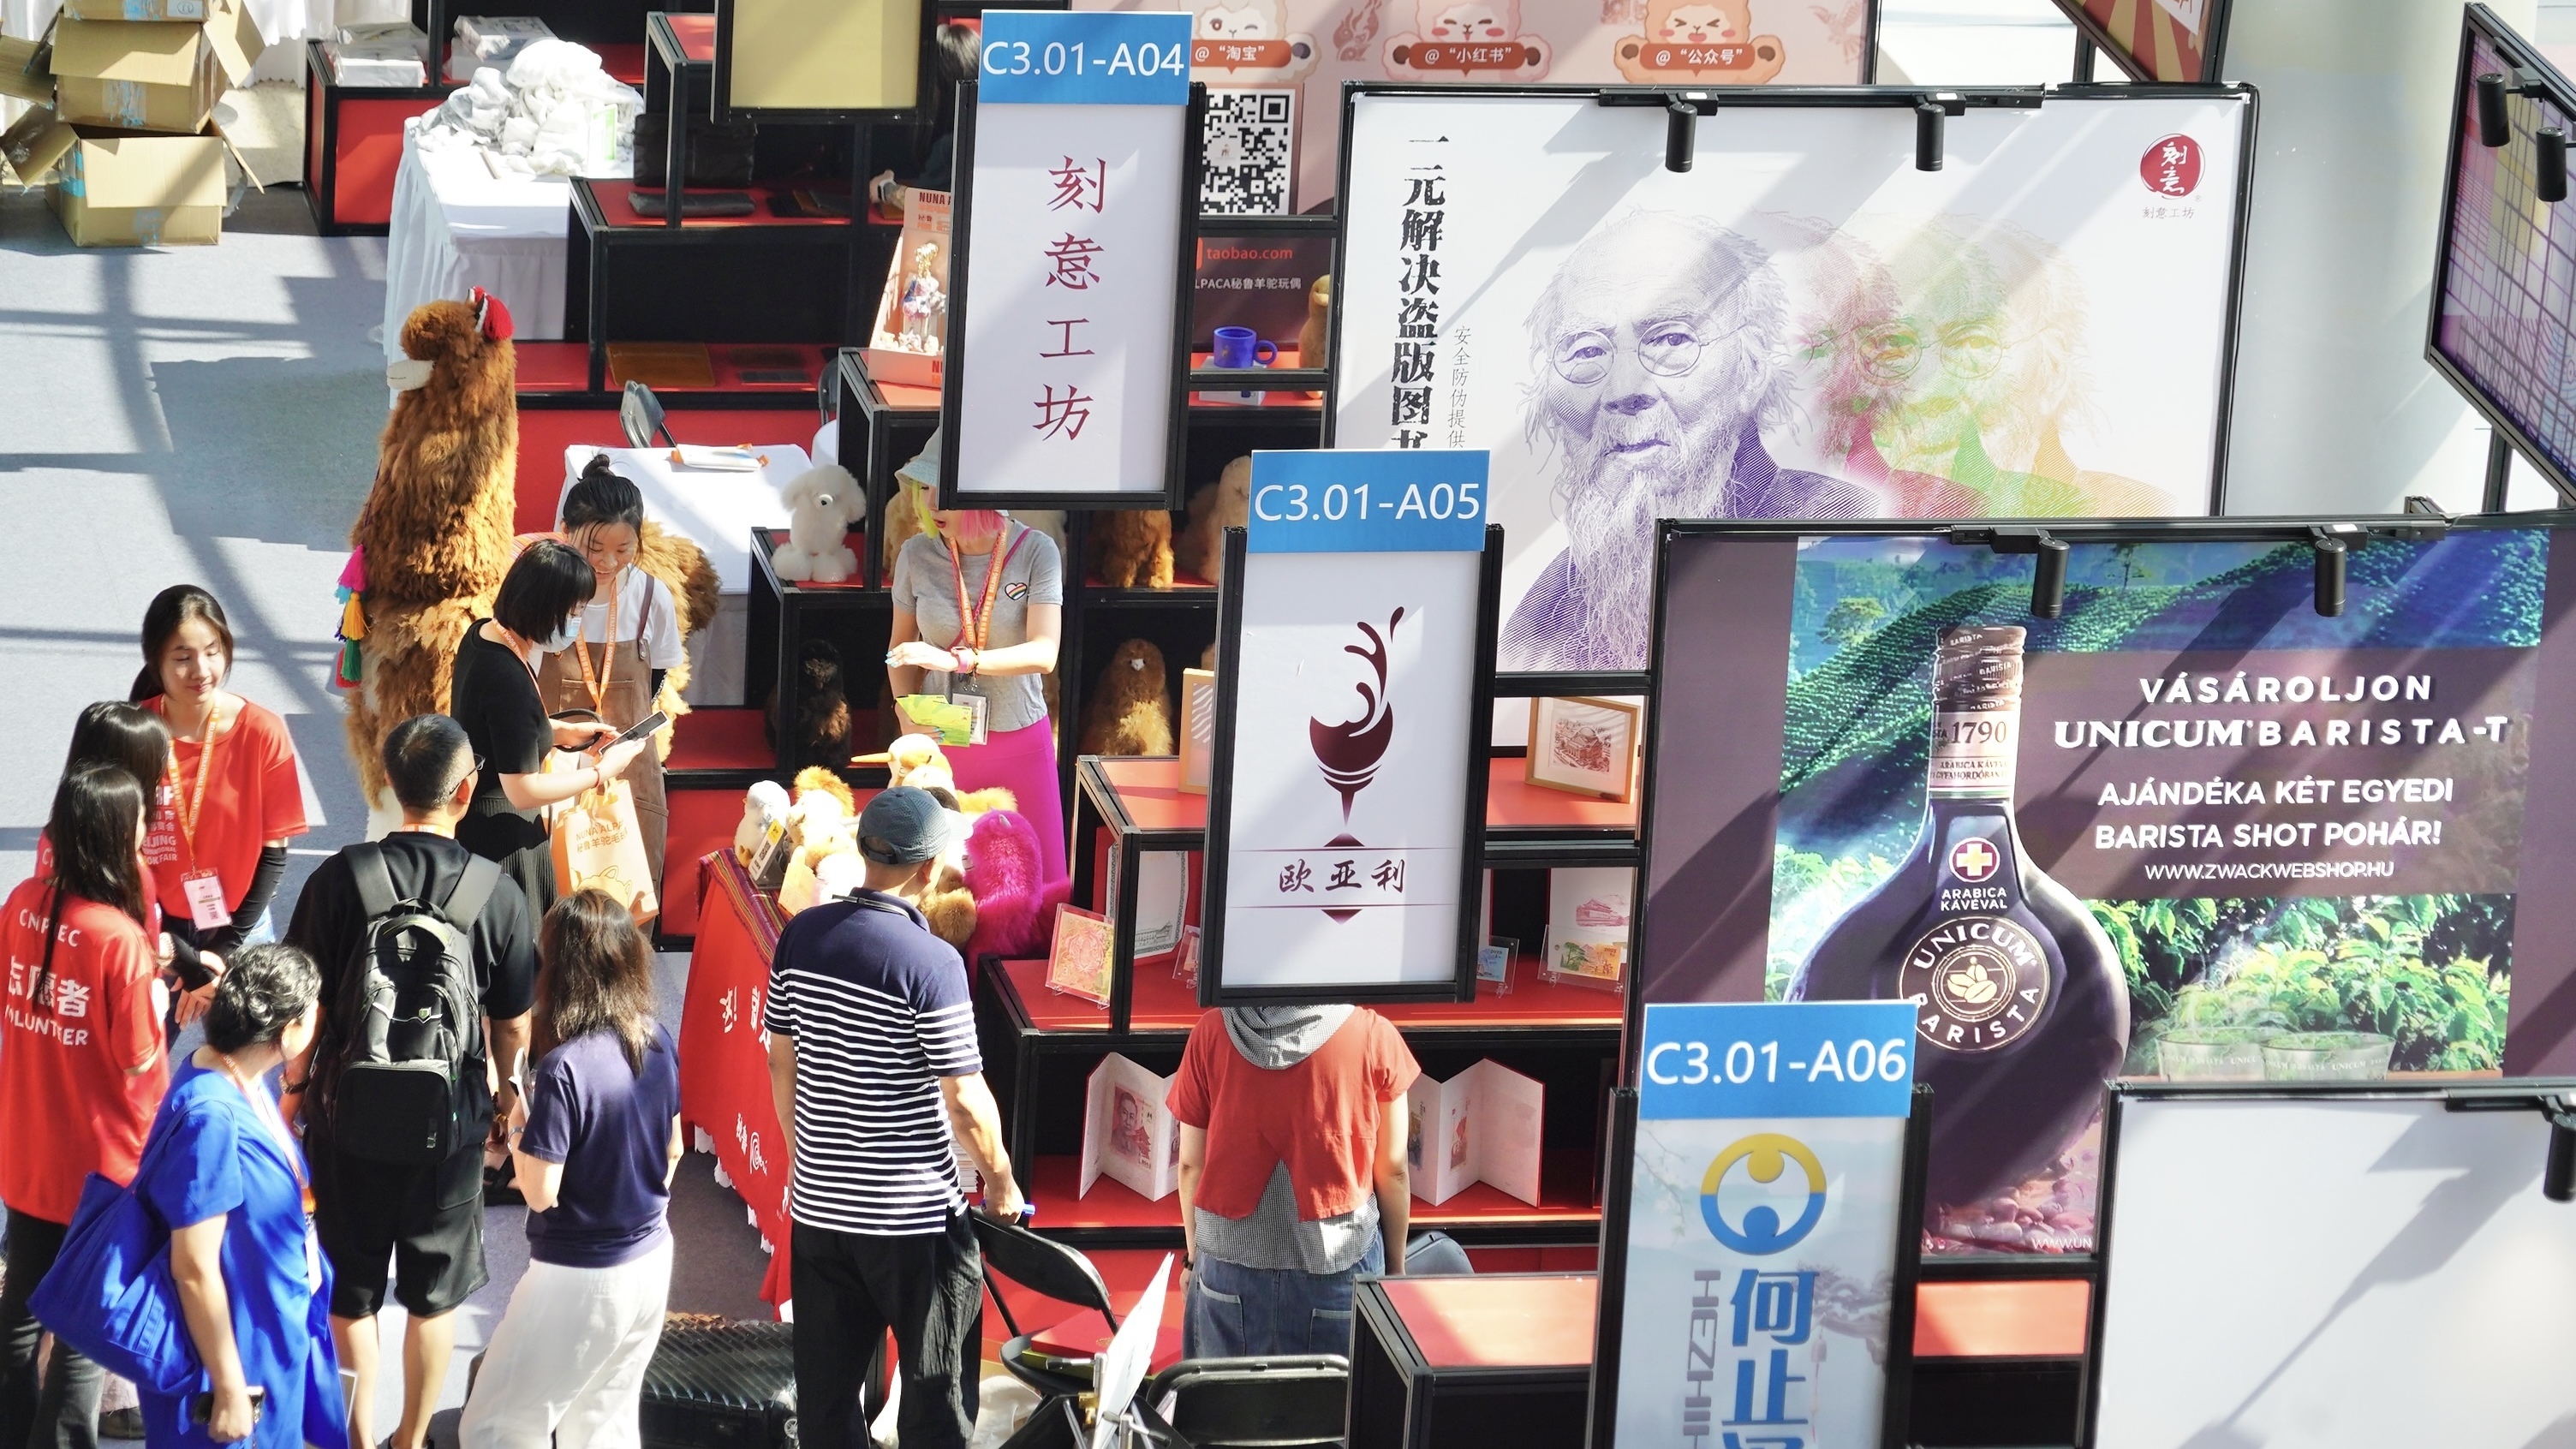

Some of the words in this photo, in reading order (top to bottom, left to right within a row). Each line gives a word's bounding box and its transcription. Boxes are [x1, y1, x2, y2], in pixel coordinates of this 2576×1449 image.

[983, 41, 1184, 75] C3.01-A04
[2142, 206, 2195, 219] 刻意工坊
[1207, 247, 1293, 259] taobao.com
[1033, 155, 1105, 441] 刻意工坊
[1255, 483, 1480, 521] C3.01-A05
[2139, 671, 2431, 704] VÁSÁROLJON
[1950, 722, 2007, 743] 1790
[2258, 716, 2508, 748] BARISTA-T
[2098, 777, 2265, 806] AJÁNDÉKA
[2275, 775, 2335, 803] KÉT
[2342, 778, 2454, 803] EGYEDI
[2096, 824, 2224, 849] BARISTA
[2233, 823, 2317, 847] SHOT
[2323, 815, 2442, 845] POHÁR!
[1279, 858, 1405, 893] 欧亚利
[2145, 861, 2395, 880] WWW.ZWACKWEBSHOP.HU
[1941, 887, 2007, 900] ARABICA
[19, 908, 81, 947] CNPEC
[1647, 1038, 1907, 1084] C3.01-A06
[2031, 1237, 2093, 1249] WWW.UN
